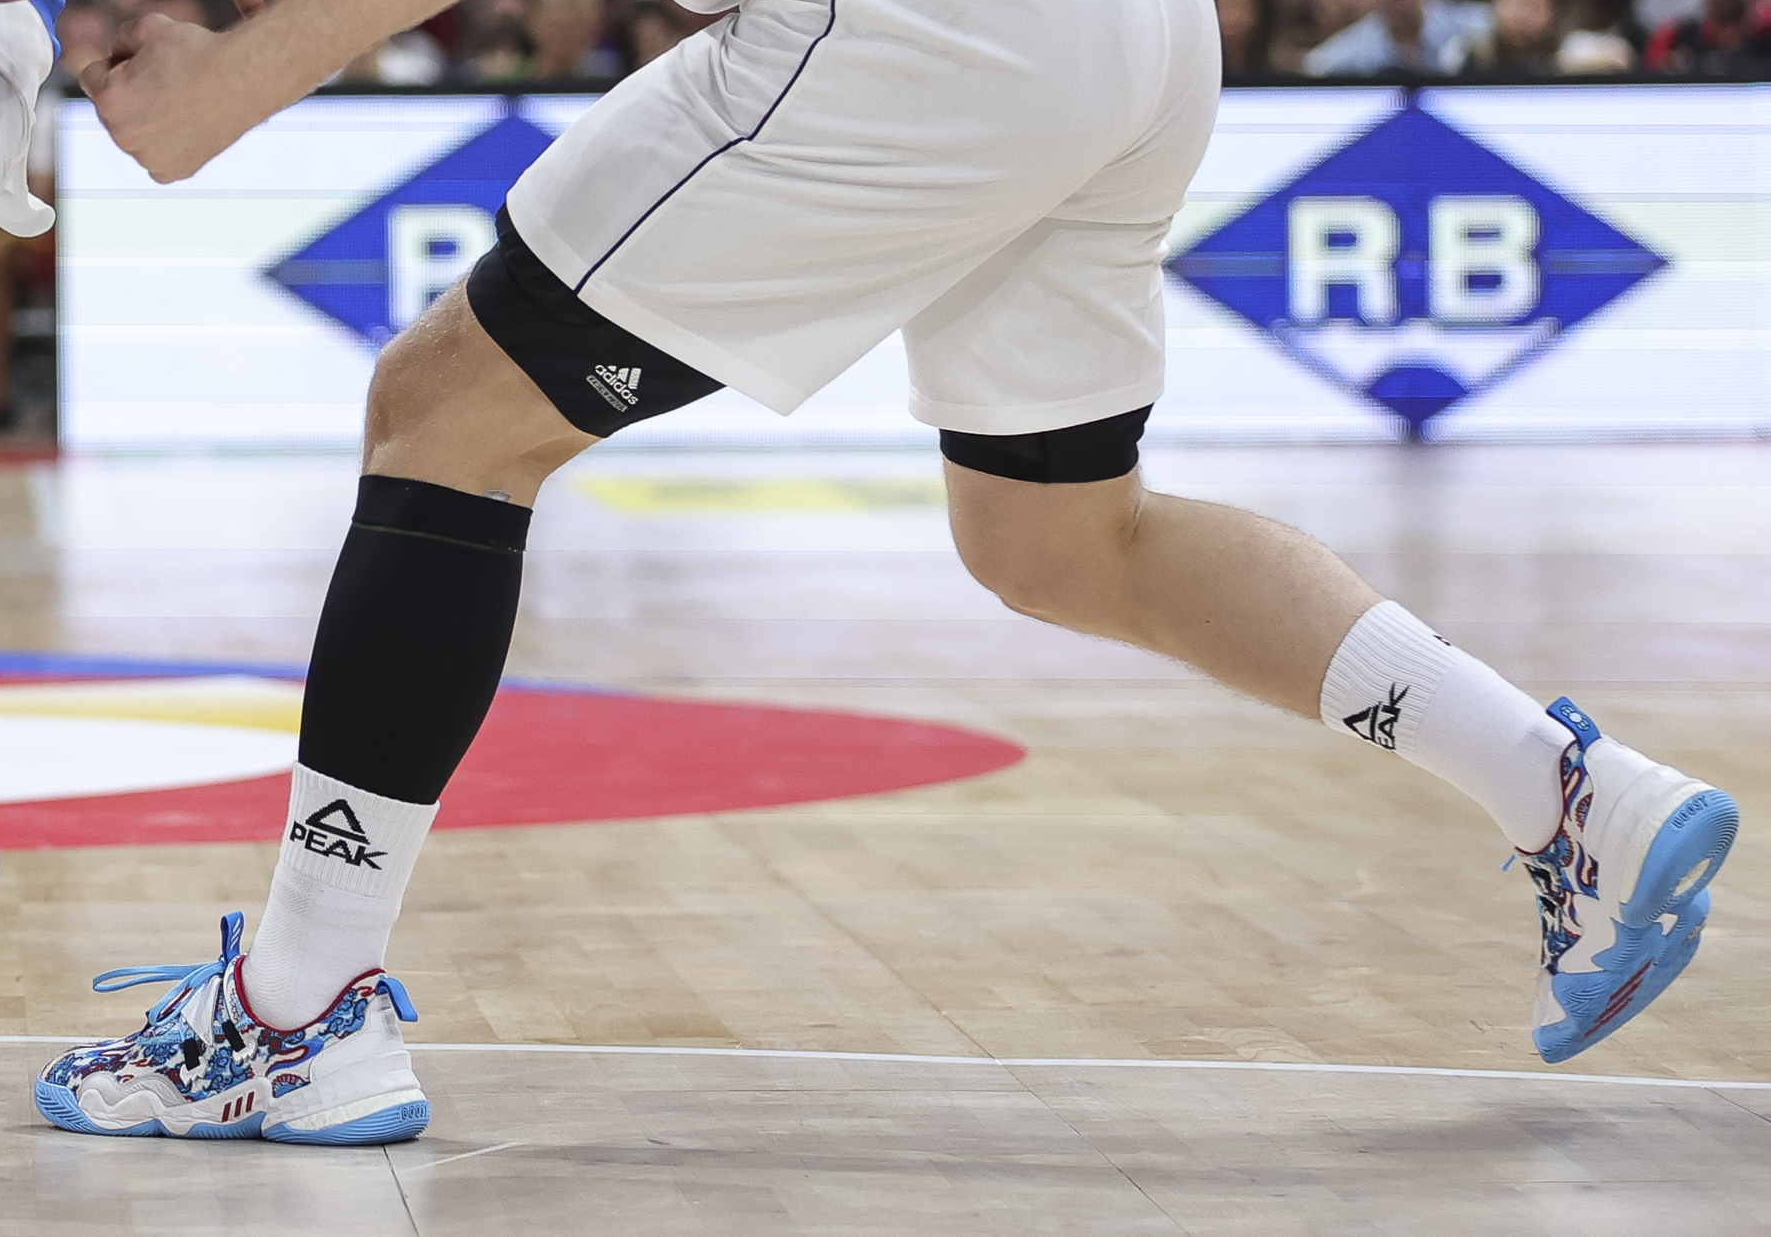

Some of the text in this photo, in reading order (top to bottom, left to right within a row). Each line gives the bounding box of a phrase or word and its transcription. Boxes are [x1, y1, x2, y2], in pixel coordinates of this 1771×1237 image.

[1286, 193, 1543, 326] RB
[594, 364, 639, 405] adidas
[1377, 682, 1410, 750] EAK
[290, 820, 388, 870] PEAK
